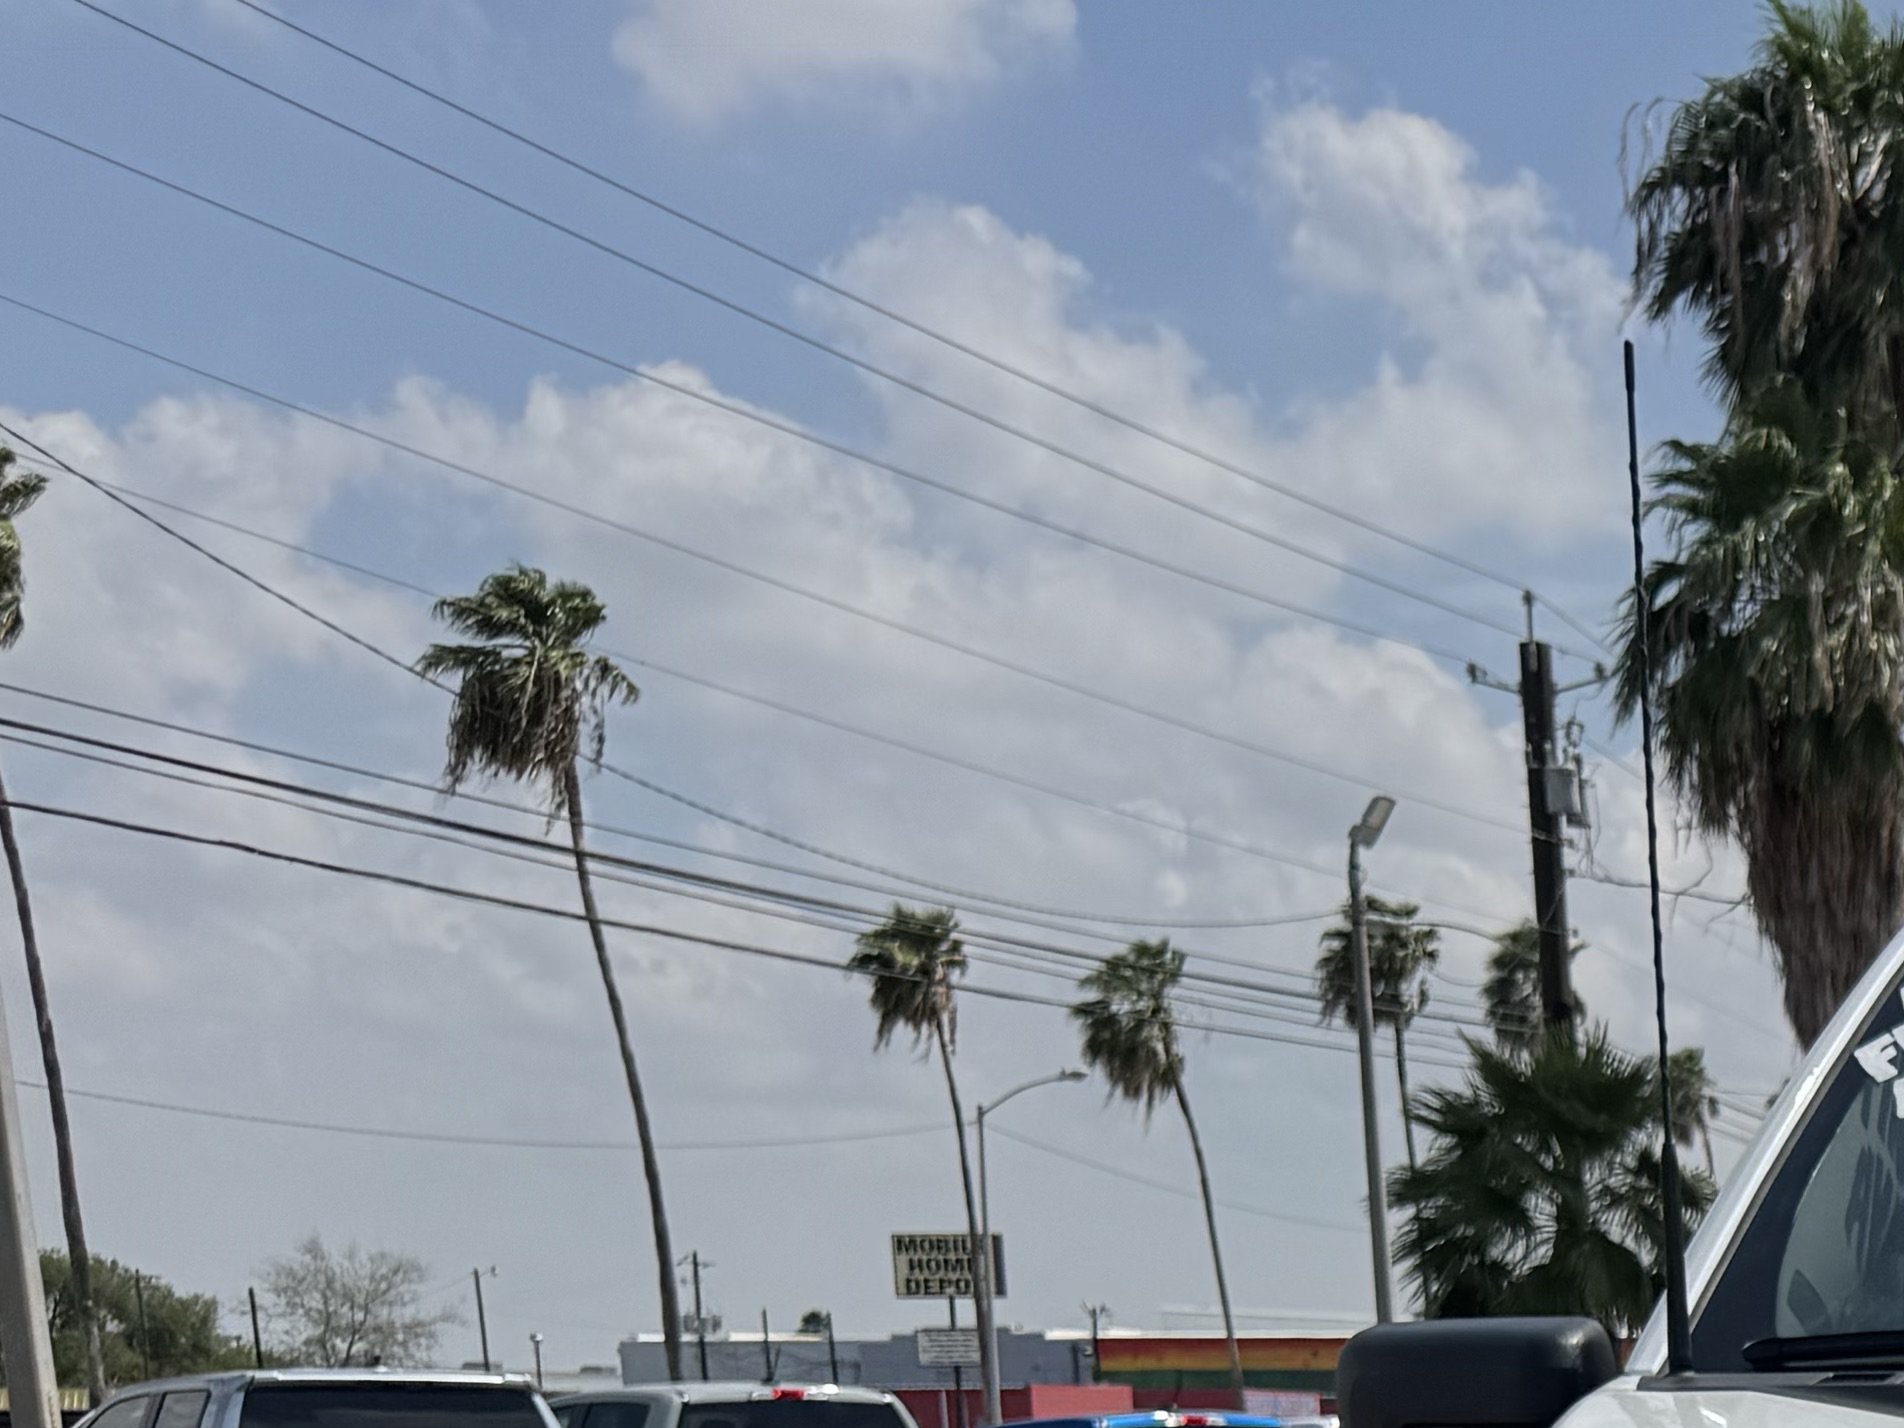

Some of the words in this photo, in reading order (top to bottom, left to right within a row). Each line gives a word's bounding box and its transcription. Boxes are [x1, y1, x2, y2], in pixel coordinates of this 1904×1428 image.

[896, 1238, 977, 1256] MOBIL
[908, 1257, 976, 1276] HOM
[905, 1277, 976, 1296] DEPO
